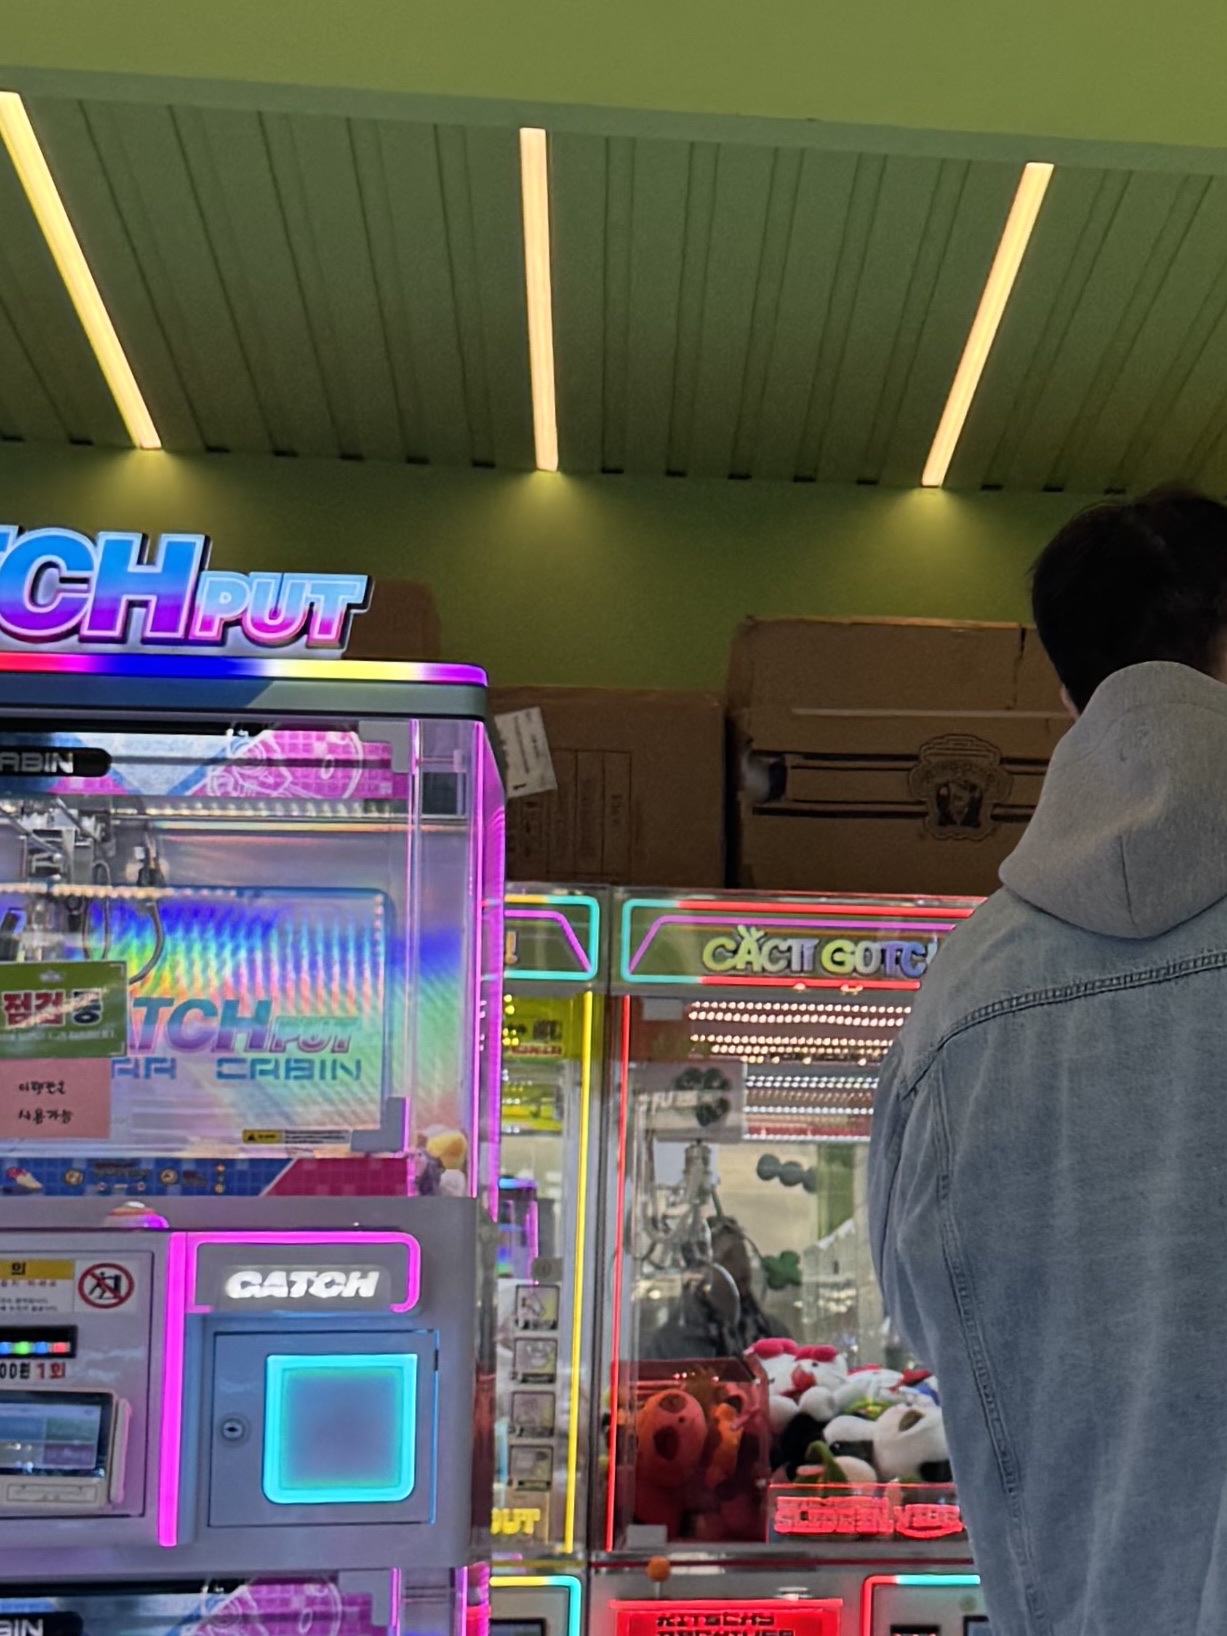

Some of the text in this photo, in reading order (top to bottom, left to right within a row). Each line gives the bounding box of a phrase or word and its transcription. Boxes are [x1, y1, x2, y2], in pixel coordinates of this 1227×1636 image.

[0, 525, 370, 647] CH PUT
[702, 924, 820, 973] CACTI
[128, 996, 273, 1055] TCH
[215, 1057, 363, 1081] CABIN
[11, 1262, 26, 1276] 의
